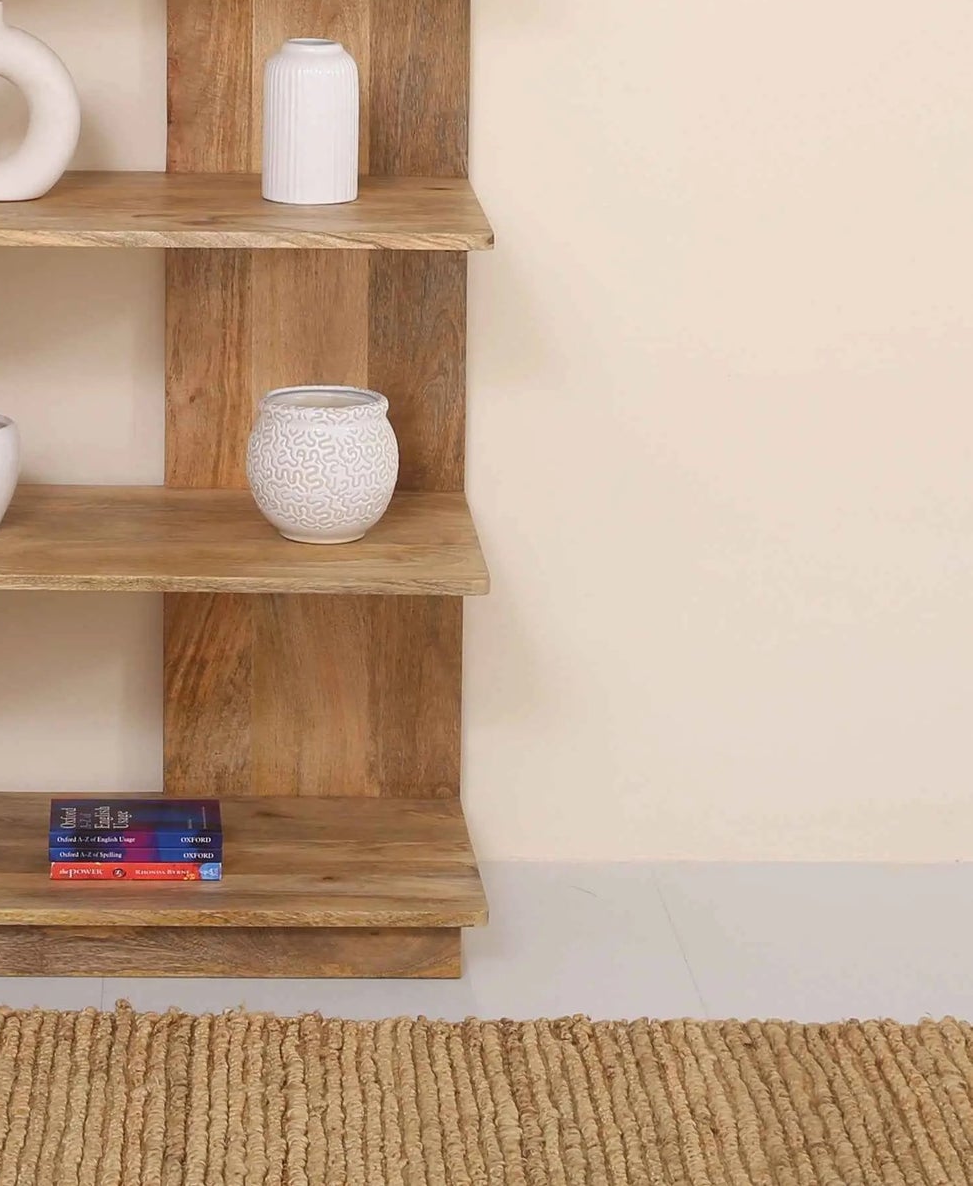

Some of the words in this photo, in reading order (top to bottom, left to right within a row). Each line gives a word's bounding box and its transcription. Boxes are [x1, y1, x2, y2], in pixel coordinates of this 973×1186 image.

[60, 807, 77, 829] Oxford
[94, 806, 113, 829] English
[113, 810, 133, 829] Usage
[97, 836, 119, 844] English
[119, 836, 136, 844] Usage
[99, 851, 123, 859] Spelling
